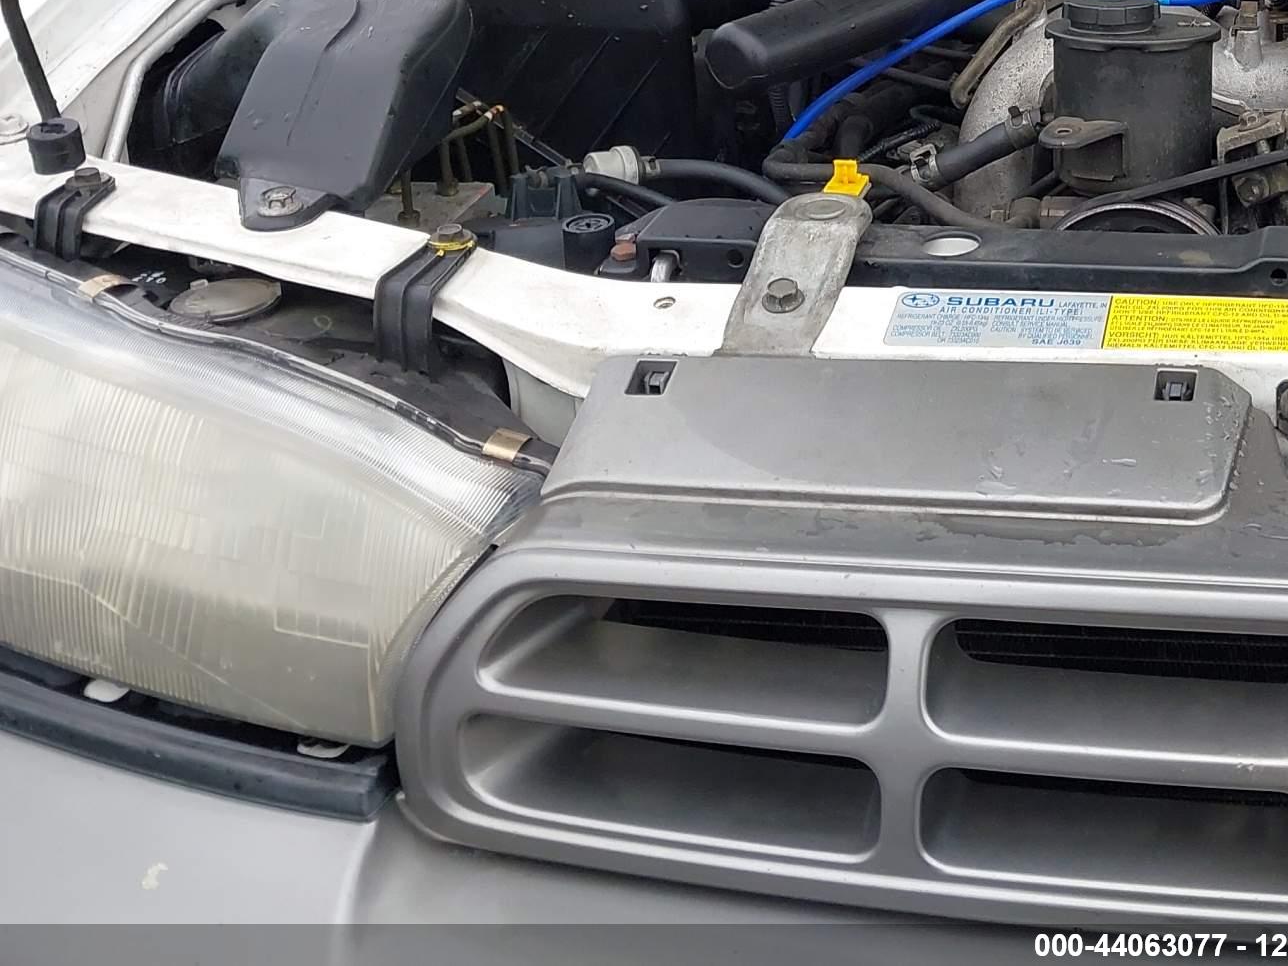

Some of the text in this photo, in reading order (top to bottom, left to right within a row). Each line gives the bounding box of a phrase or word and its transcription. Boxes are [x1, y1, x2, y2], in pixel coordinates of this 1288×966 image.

[946, 296, 1054, 308] SUBARU
[939, 306, 957, 314] AIR
[961, 306, 1032, 315] CONDITIONER
